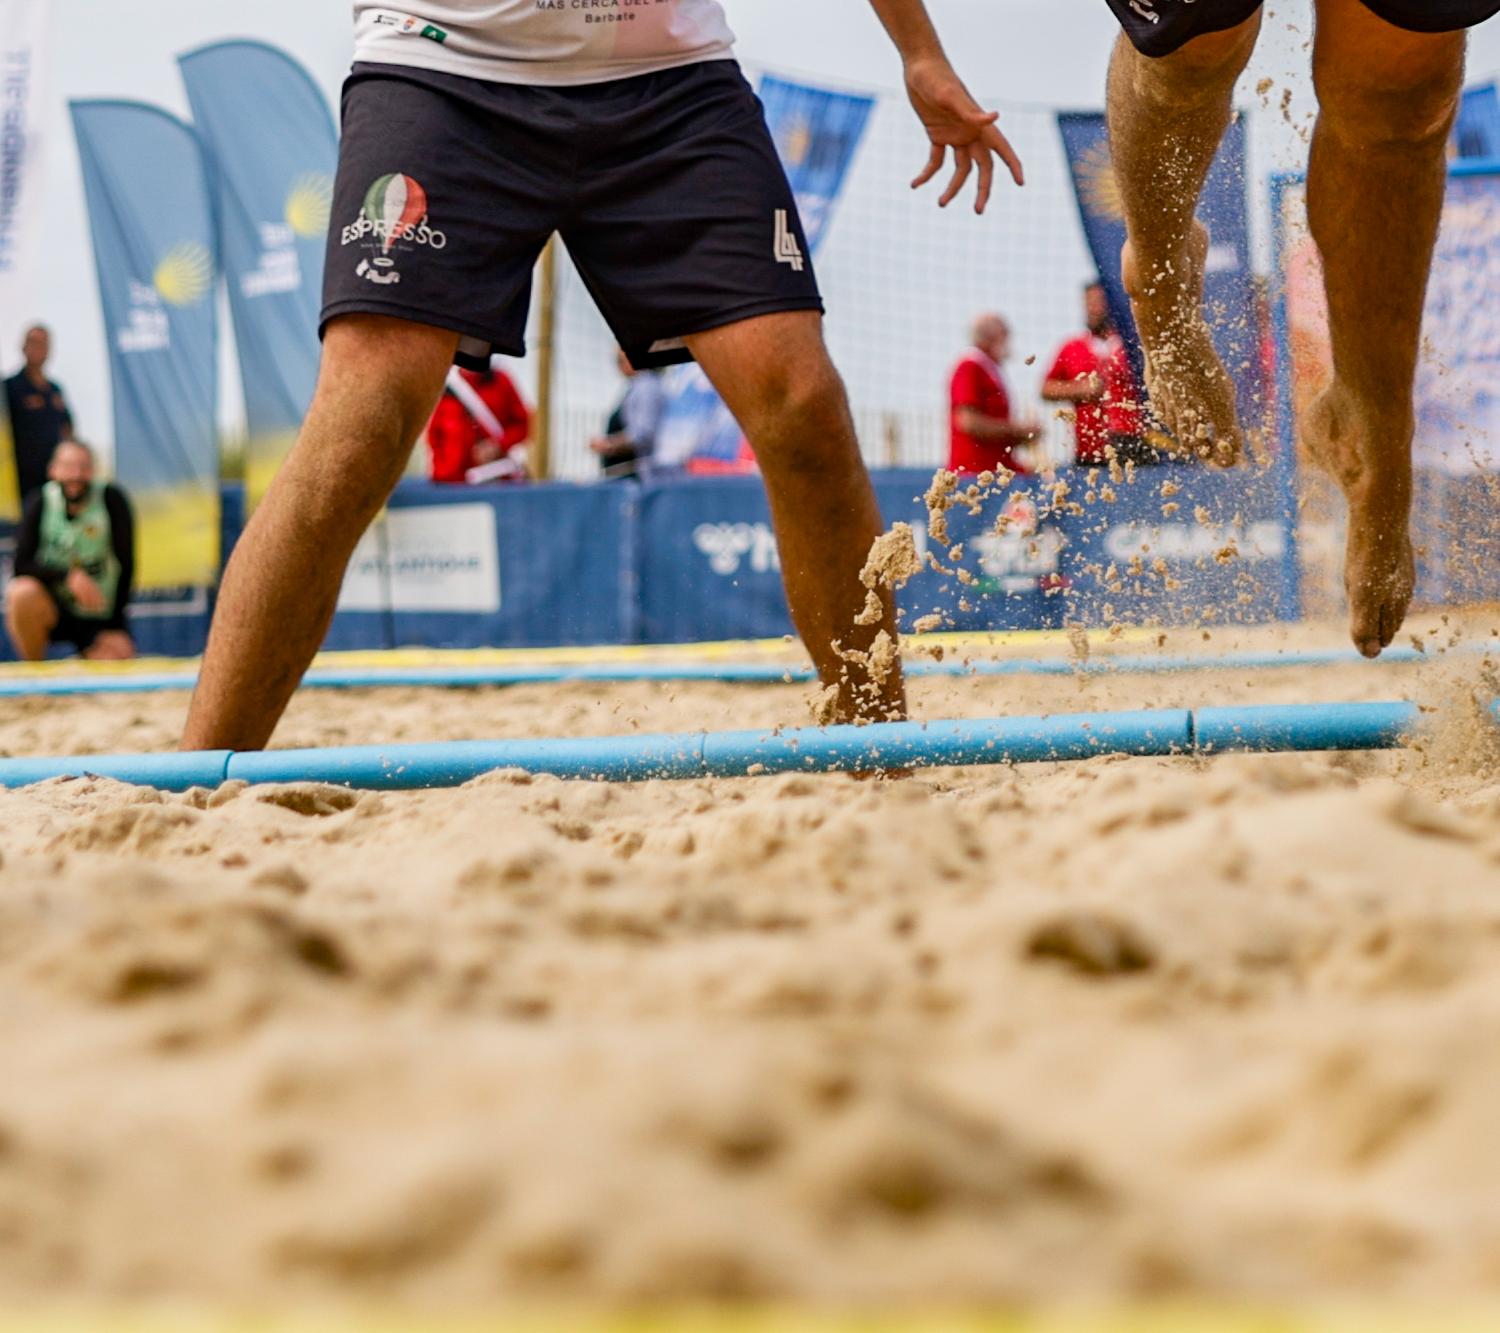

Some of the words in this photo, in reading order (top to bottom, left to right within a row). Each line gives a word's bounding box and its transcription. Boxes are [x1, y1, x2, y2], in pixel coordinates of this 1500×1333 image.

[585, 11, 636, 24] Barbate
[341, 219, 447, 249] ESPRESSO
[773, 209, 804, 271] 4
